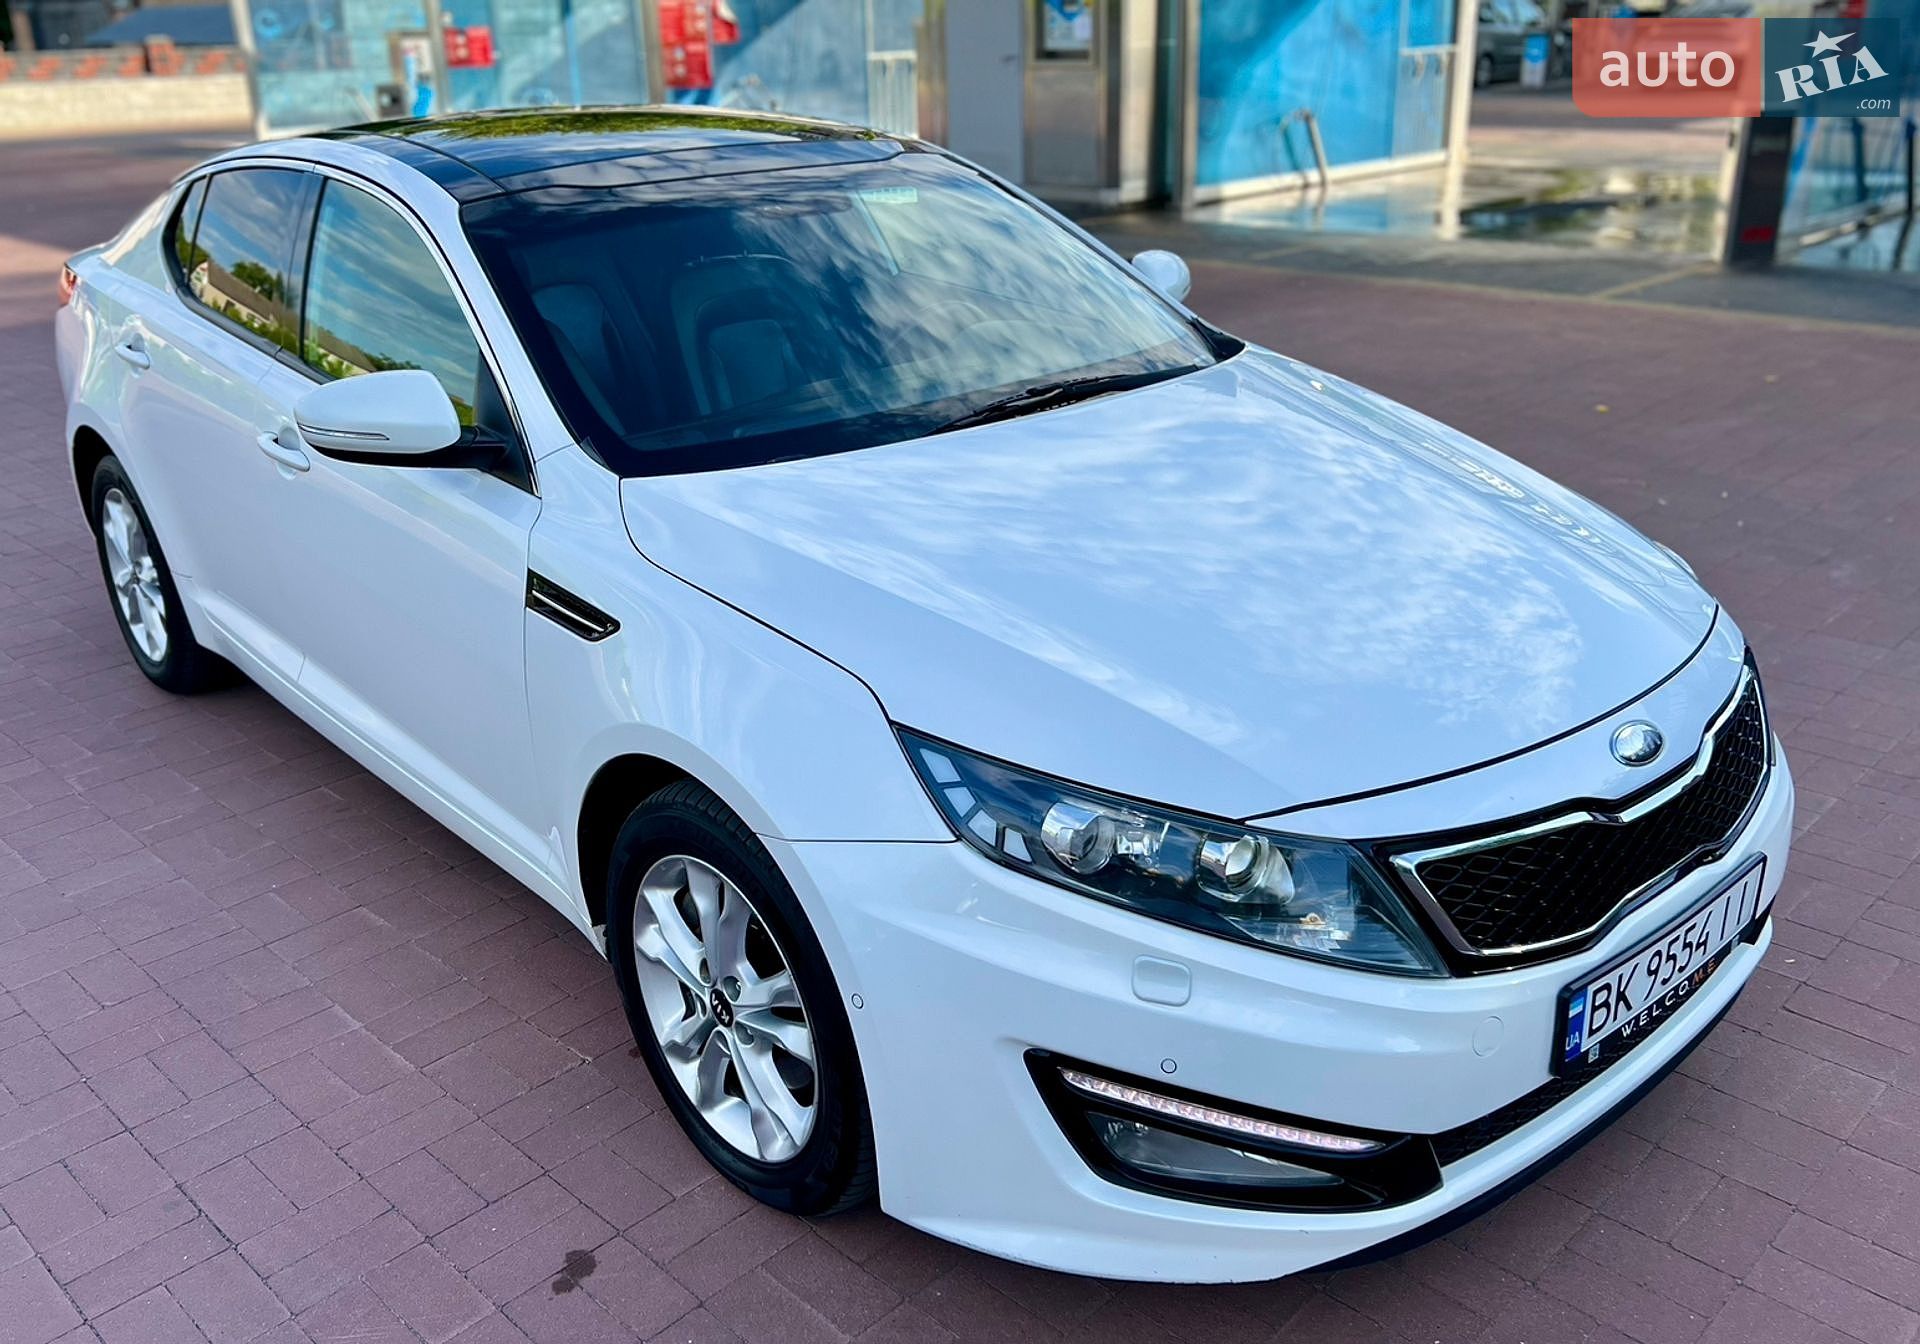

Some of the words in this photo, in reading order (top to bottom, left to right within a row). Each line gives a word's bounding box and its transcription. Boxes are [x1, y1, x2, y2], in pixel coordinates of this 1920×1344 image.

[1587, 962, 1640, 1040] BK
[1643, 909, 1713, 1001] 9554
[1565, 1031, 1580, 1051] UA
